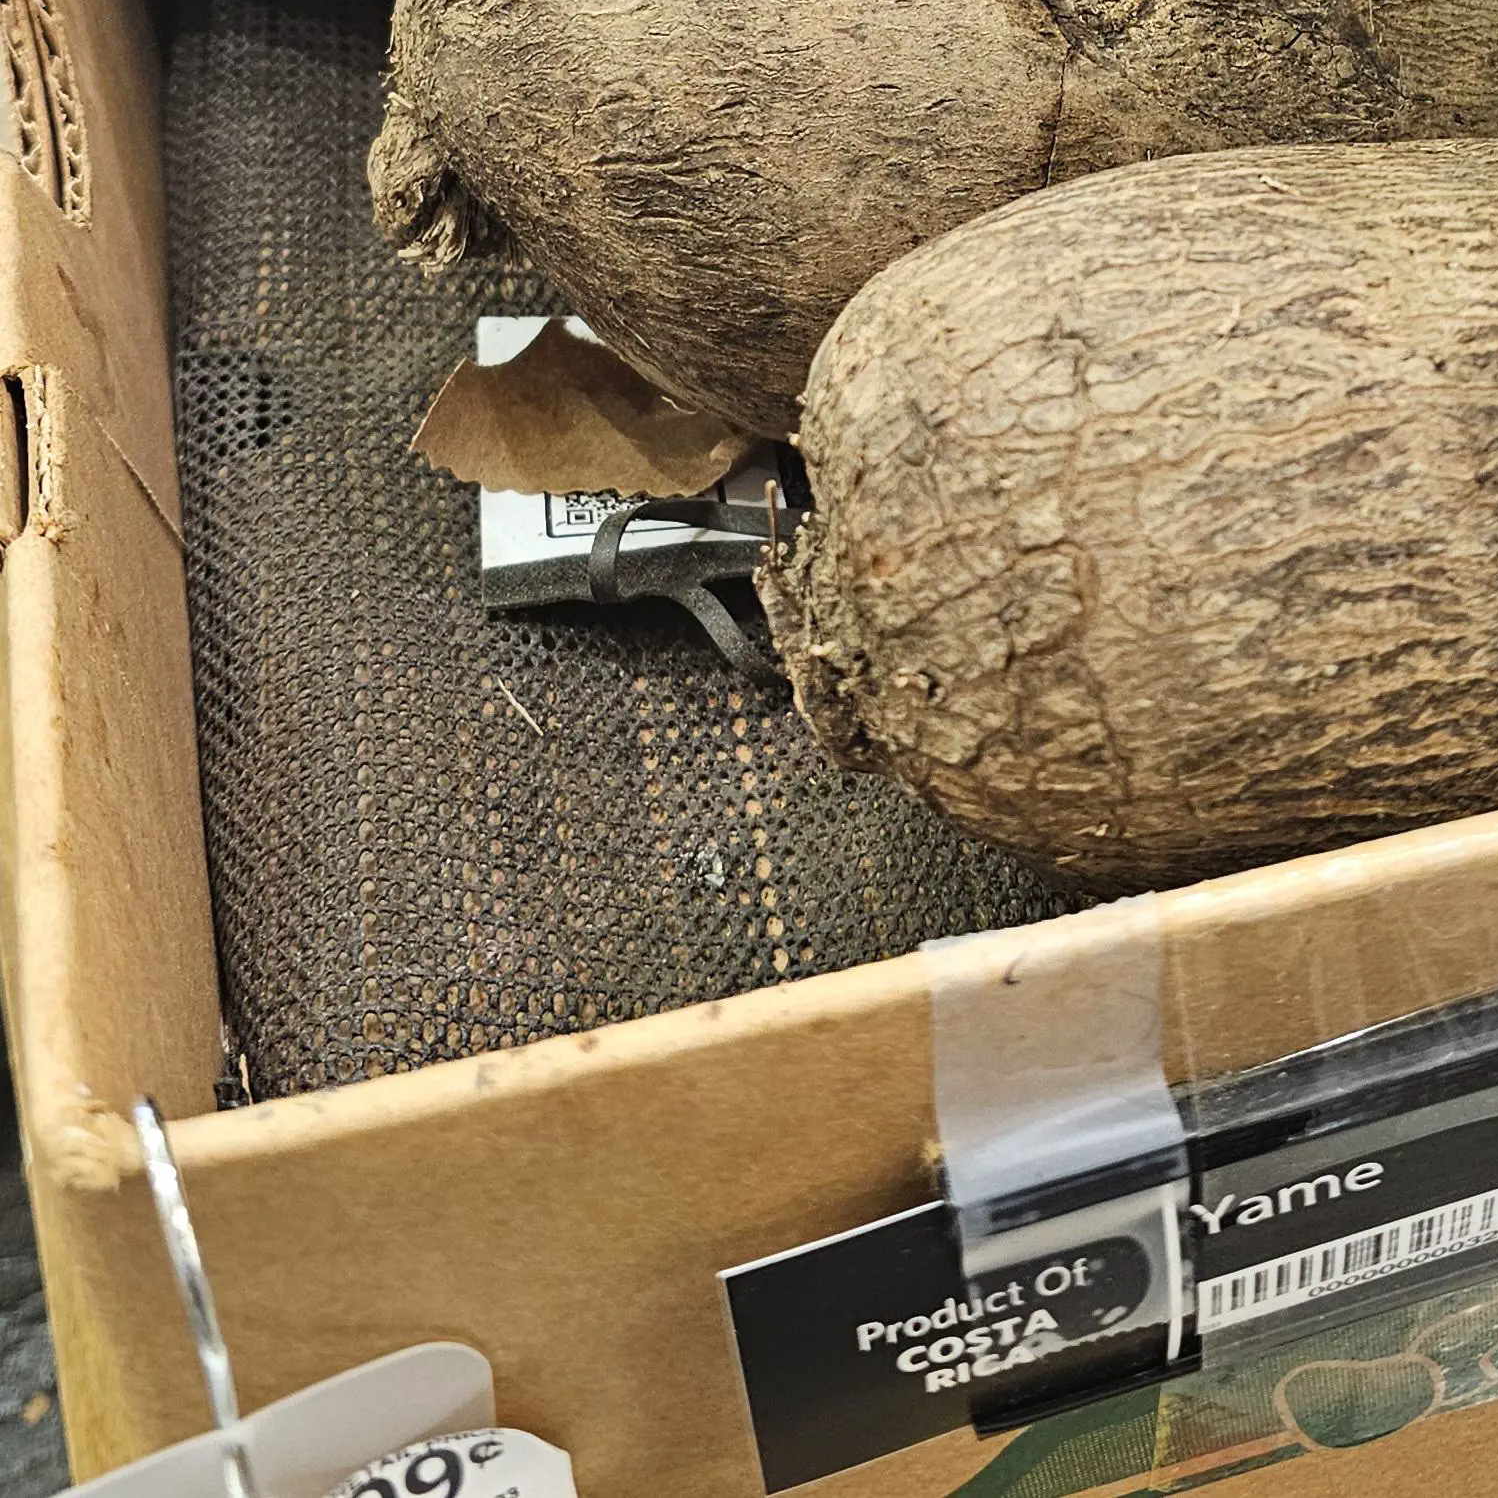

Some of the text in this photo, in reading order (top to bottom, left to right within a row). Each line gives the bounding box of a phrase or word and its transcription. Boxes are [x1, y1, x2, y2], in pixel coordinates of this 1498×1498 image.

[1189, 1160, 1385, 1235] Yame
[855, 1257, 1091, 1352] Product Of
[896, 1308, 1059, 1373] COSTA
[924, 1344, 1038, 1394] RICA
